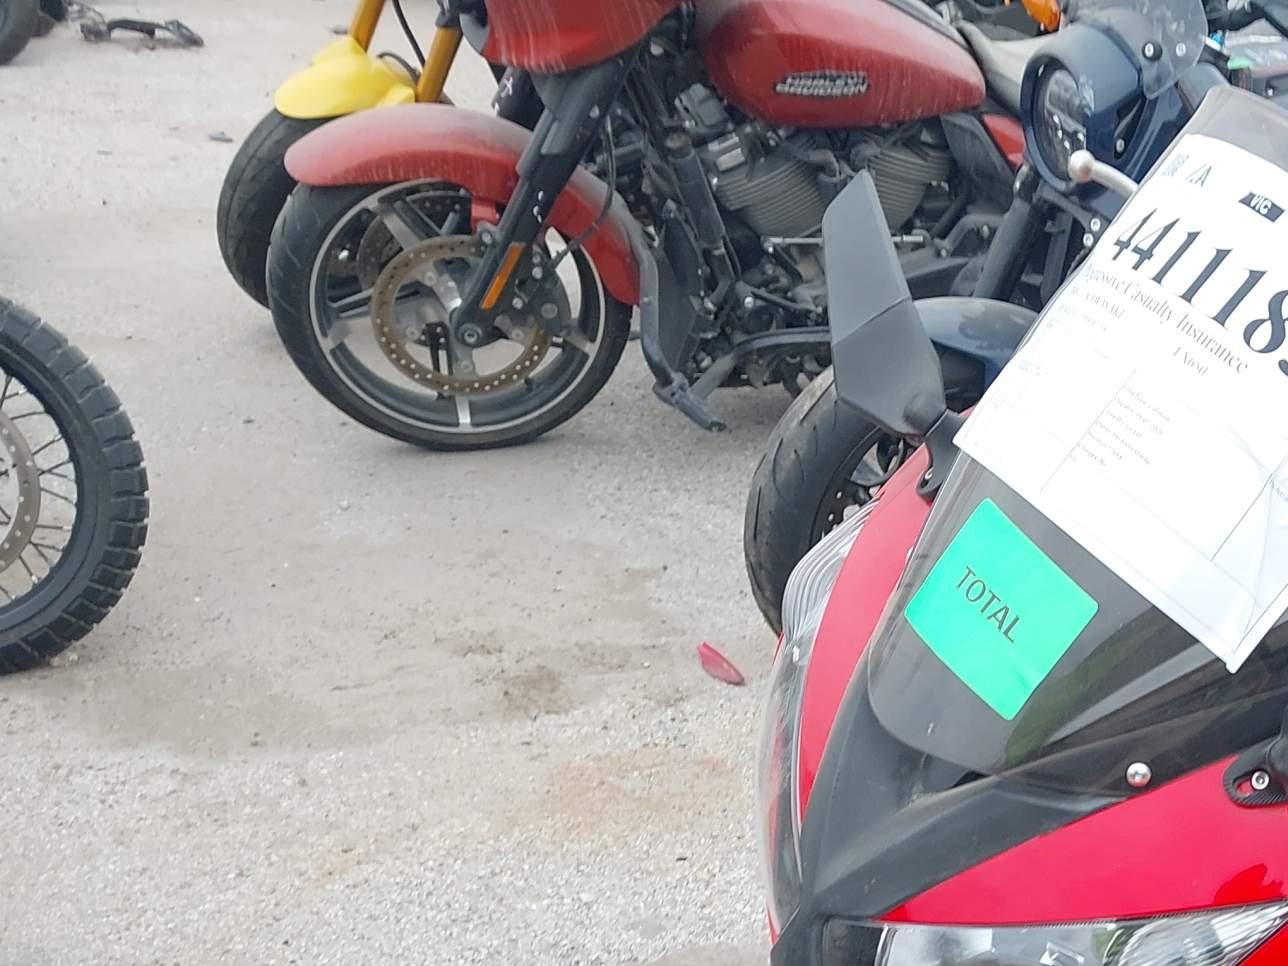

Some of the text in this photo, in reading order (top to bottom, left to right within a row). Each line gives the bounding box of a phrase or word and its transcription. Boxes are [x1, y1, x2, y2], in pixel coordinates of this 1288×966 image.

[1125, 280, 1175, 325] Casualty
[1176, 313, 1249, 375] Insurance
[956, 565, 1020, 644] TOTAL
